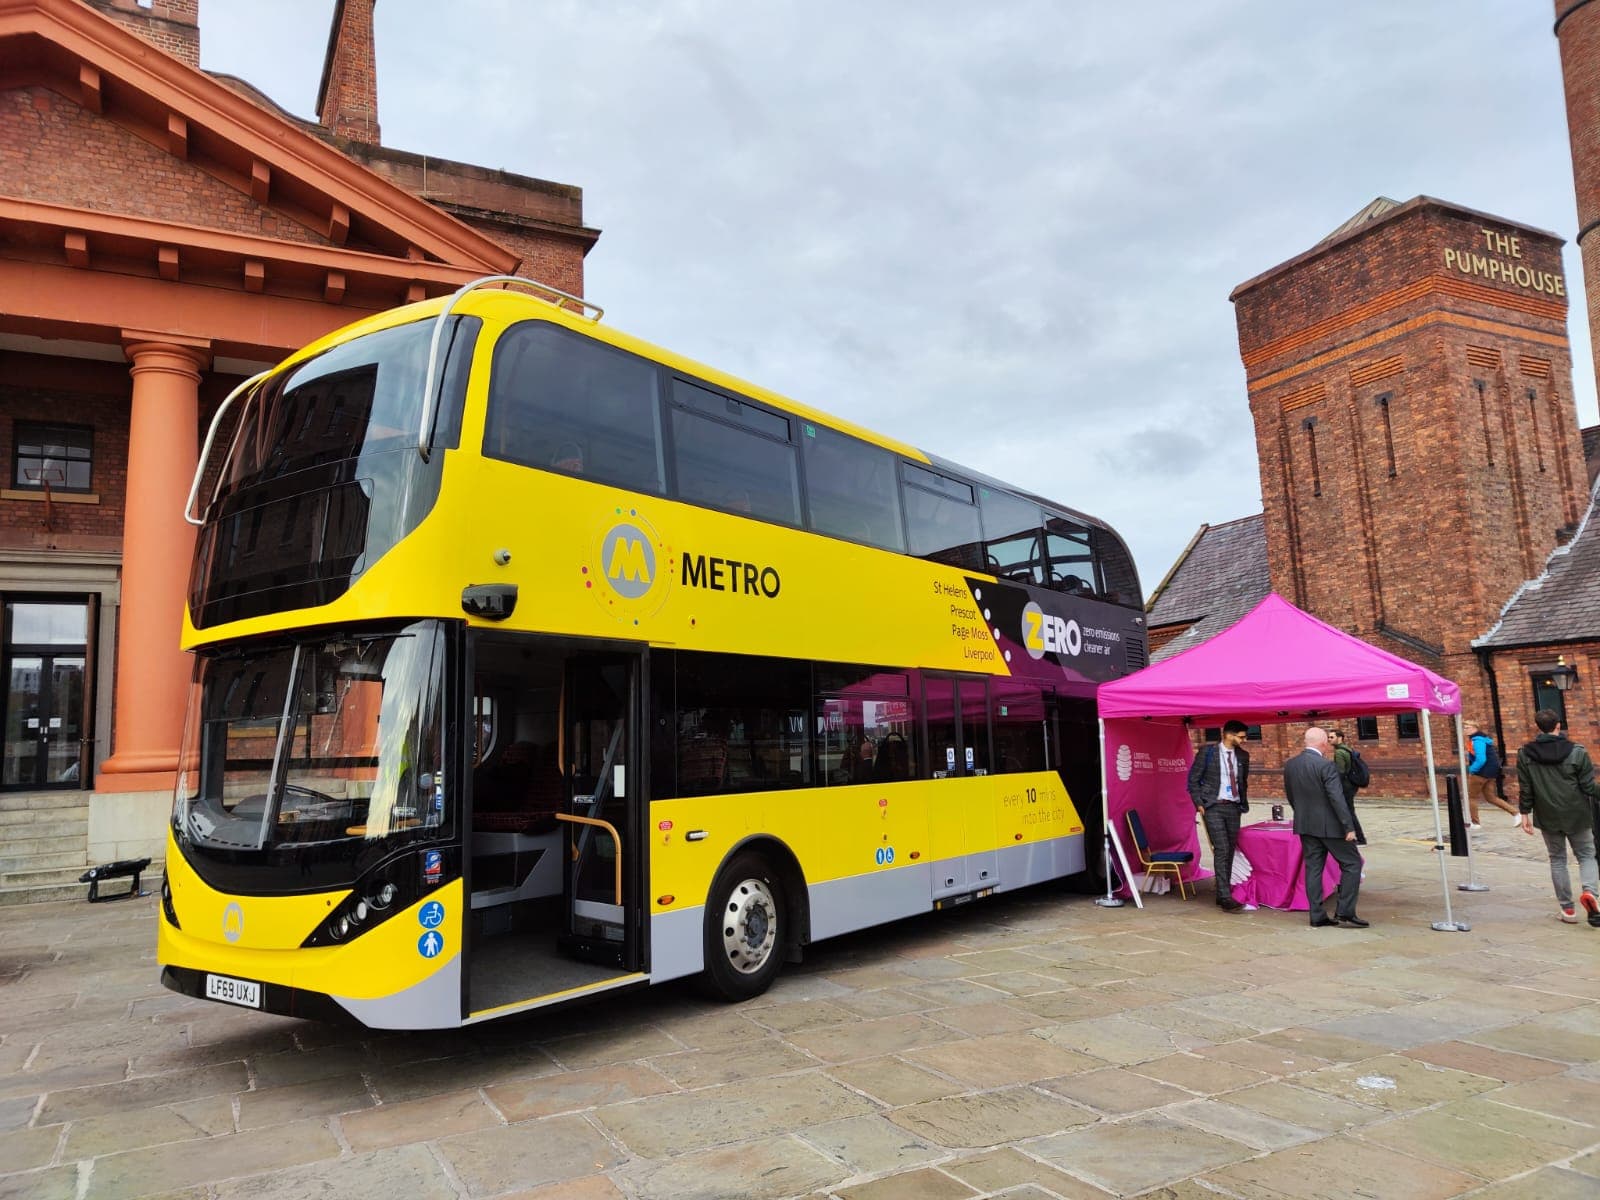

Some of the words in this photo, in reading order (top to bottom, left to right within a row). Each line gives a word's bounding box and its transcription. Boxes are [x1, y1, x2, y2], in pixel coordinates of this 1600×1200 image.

[1482, 229, 1522, 259] THE
[1445, 248, 1565, 296] PUMPHOUSE
[681, 552, 780, 599] METRO
[933, 581, 942, 595] St
[943, 583, 968, 599] Helens
[950, 604, 976, 621] Prescot
[951, 623, 970, 641] Page
[971, 627, 989, 641] Moss
[1026, 611, 1081, 656] ZERO
[1083, 626, 1095, 638] zero
[1095, 627, 1121, 642] emissions
[963, 645, 995, 662] Liverpool
[1083, 639, 1103, 655] cleaner
[1003, 794, 1024, 809] every
[1025, 787, 1037, 804] 10
[1038, 808, 1051, 823] the
[1051, 807, 1065, 823] city
[210, 977, 234, 999] LF69
[236, 983, 256, 1003] UXJ
